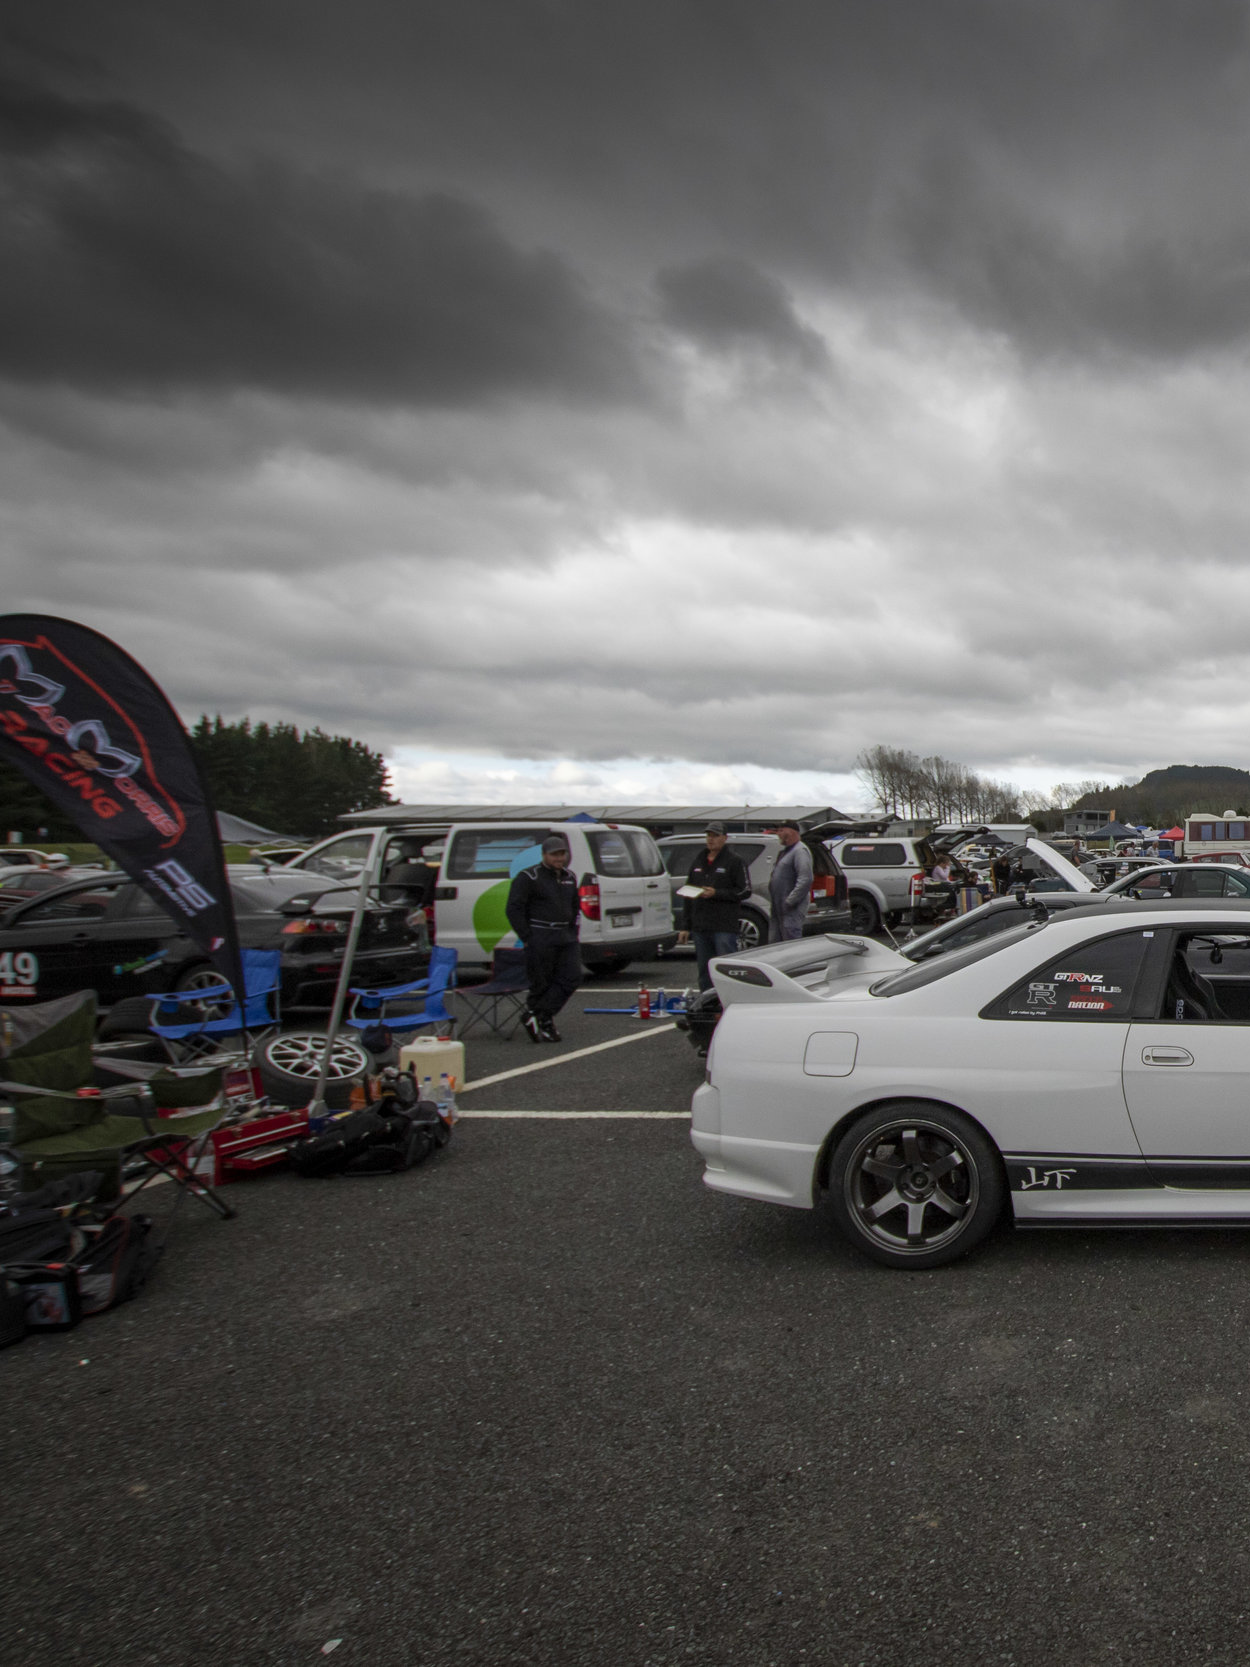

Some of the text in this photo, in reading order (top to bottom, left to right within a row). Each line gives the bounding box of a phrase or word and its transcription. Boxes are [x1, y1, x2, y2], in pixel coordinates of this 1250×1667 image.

[0, 710, 124, 819] RACING
[154, 859, 217, 910] PS
[0, 951, 39, 985] 49
